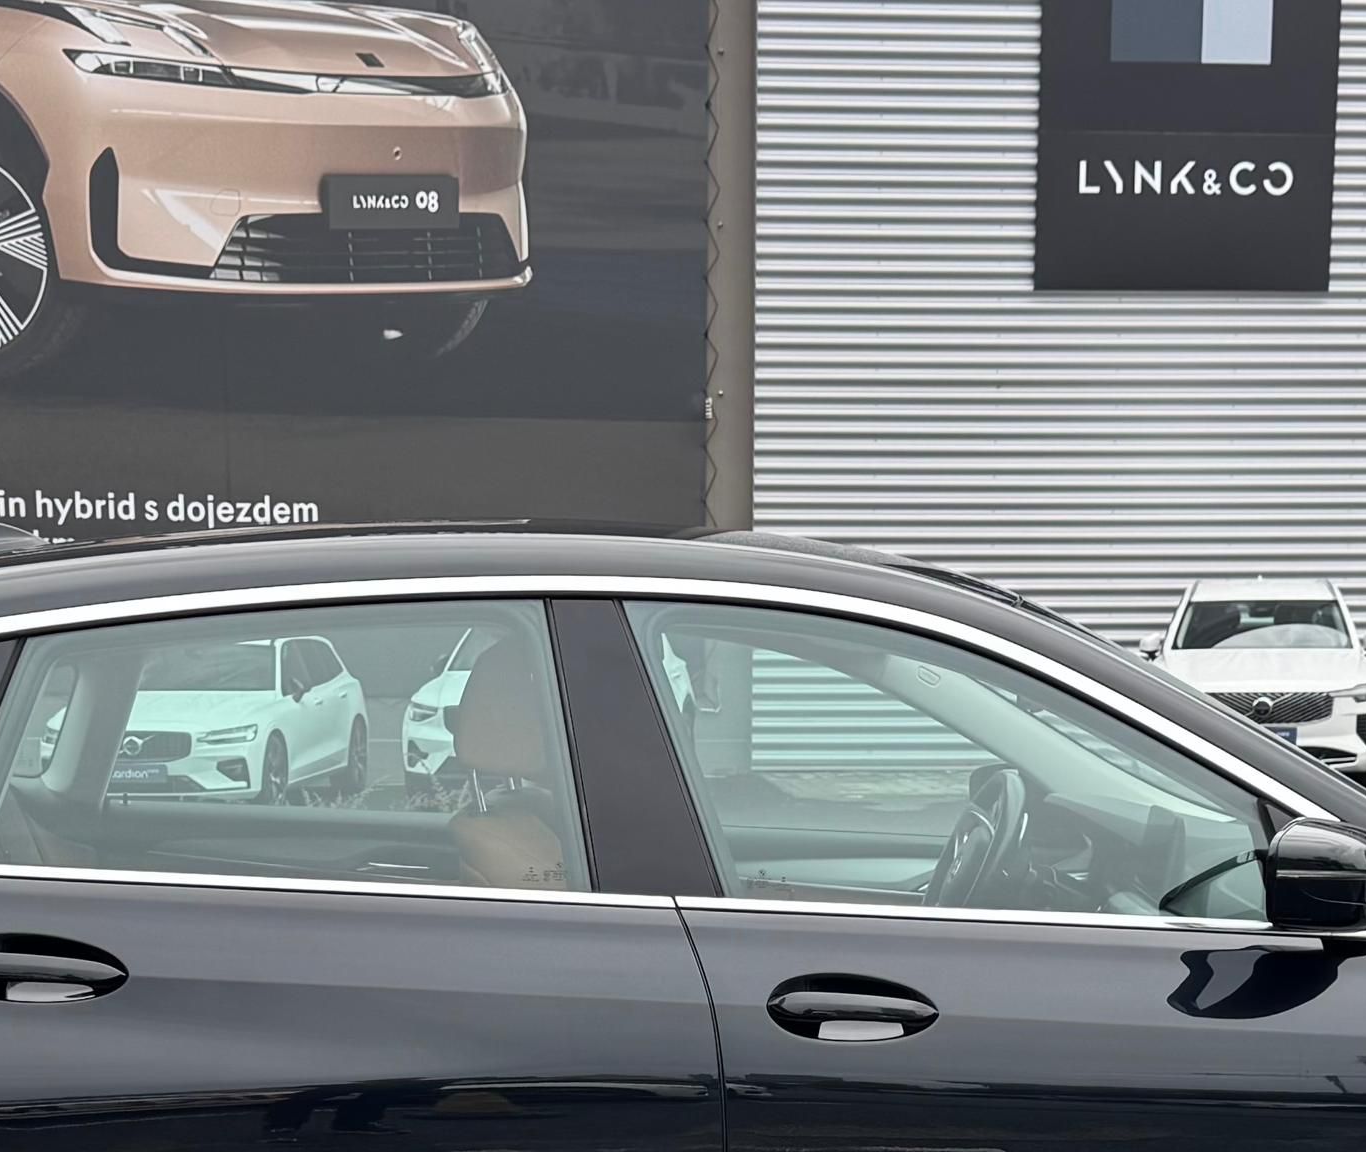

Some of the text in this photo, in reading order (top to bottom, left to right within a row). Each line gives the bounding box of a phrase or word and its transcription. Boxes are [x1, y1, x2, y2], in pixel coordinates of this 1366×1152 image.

[1078, 159, 1294, 196] LYNK&CO
[352, 190, 439, 213] LYNK&CO 08
[35, 489, 136, 525] hybrid
[144, 499, 159, 521] s
[166, 494, 319, 528] dojezdem
